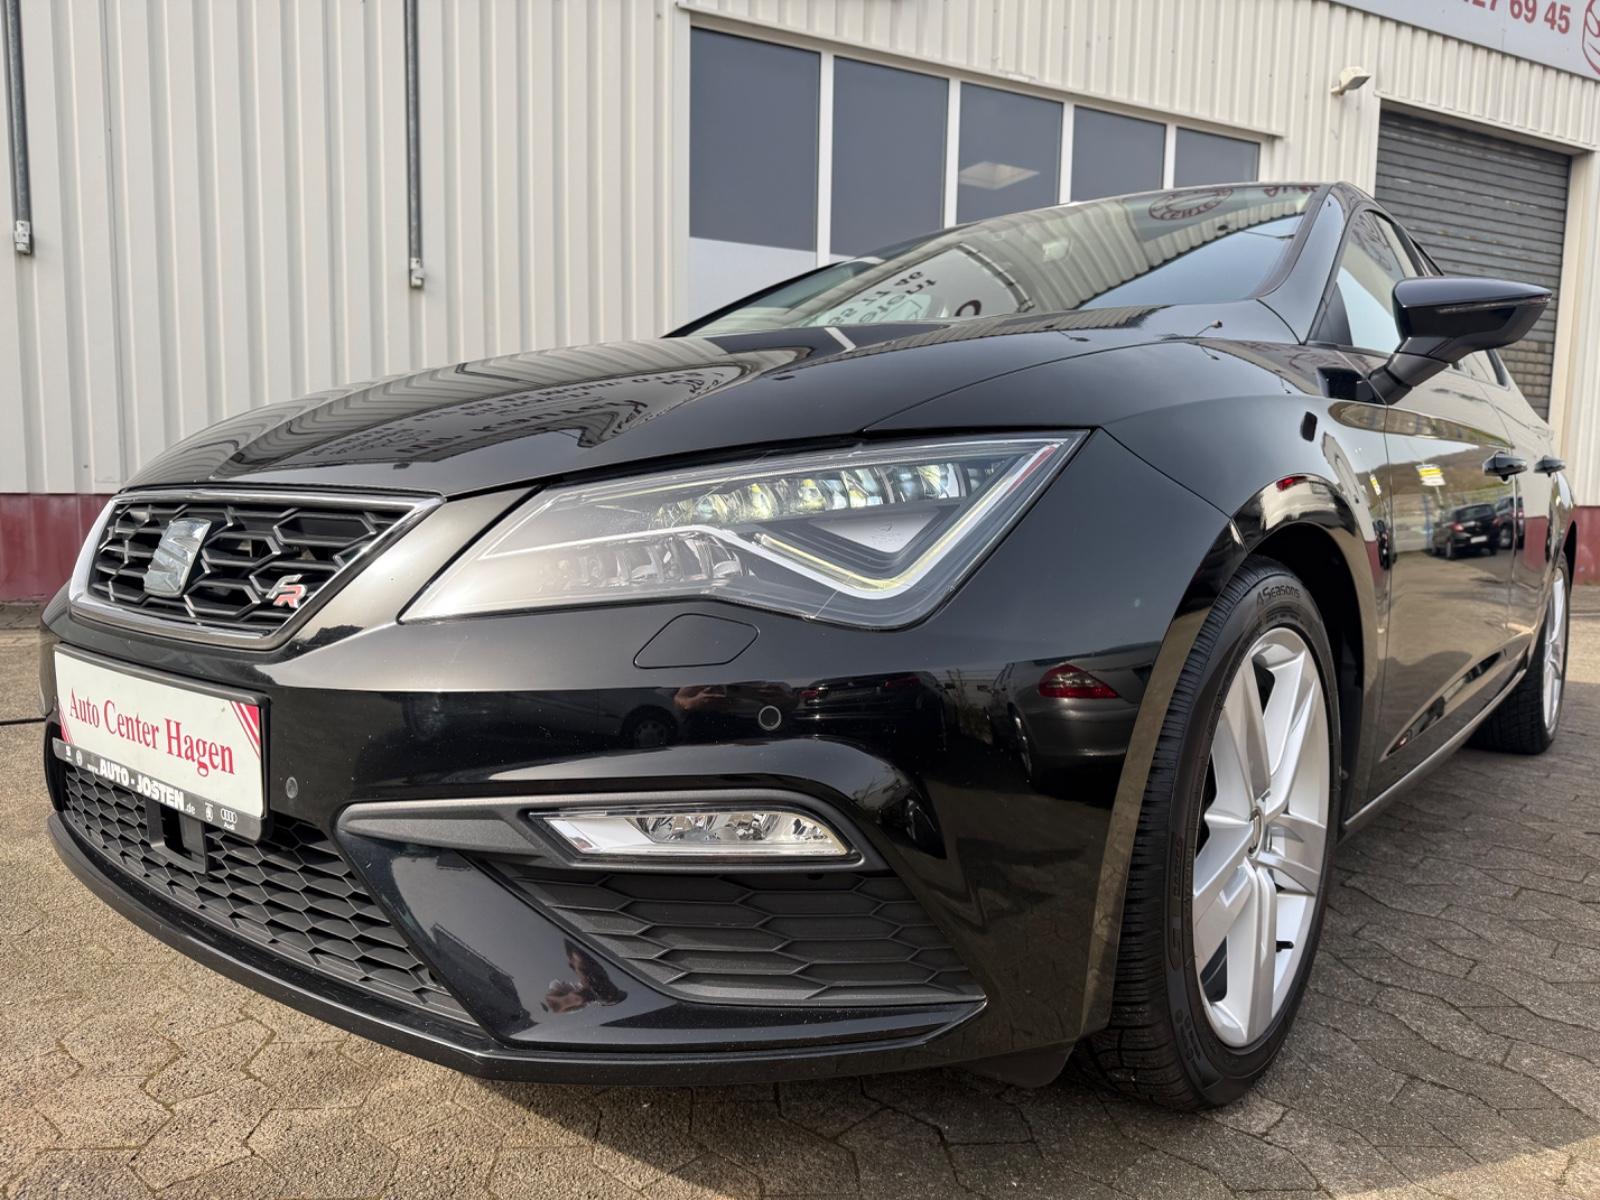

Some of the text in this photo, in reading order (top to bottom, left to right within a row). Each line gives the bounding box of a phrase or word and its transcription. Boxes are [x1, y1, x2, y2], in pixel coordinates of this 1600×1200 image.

[1510, 0, 1571, 34] 69 45
[265, 574, 308, 608] FR
[69, 688, 236, 777] Auto Center Hagen
